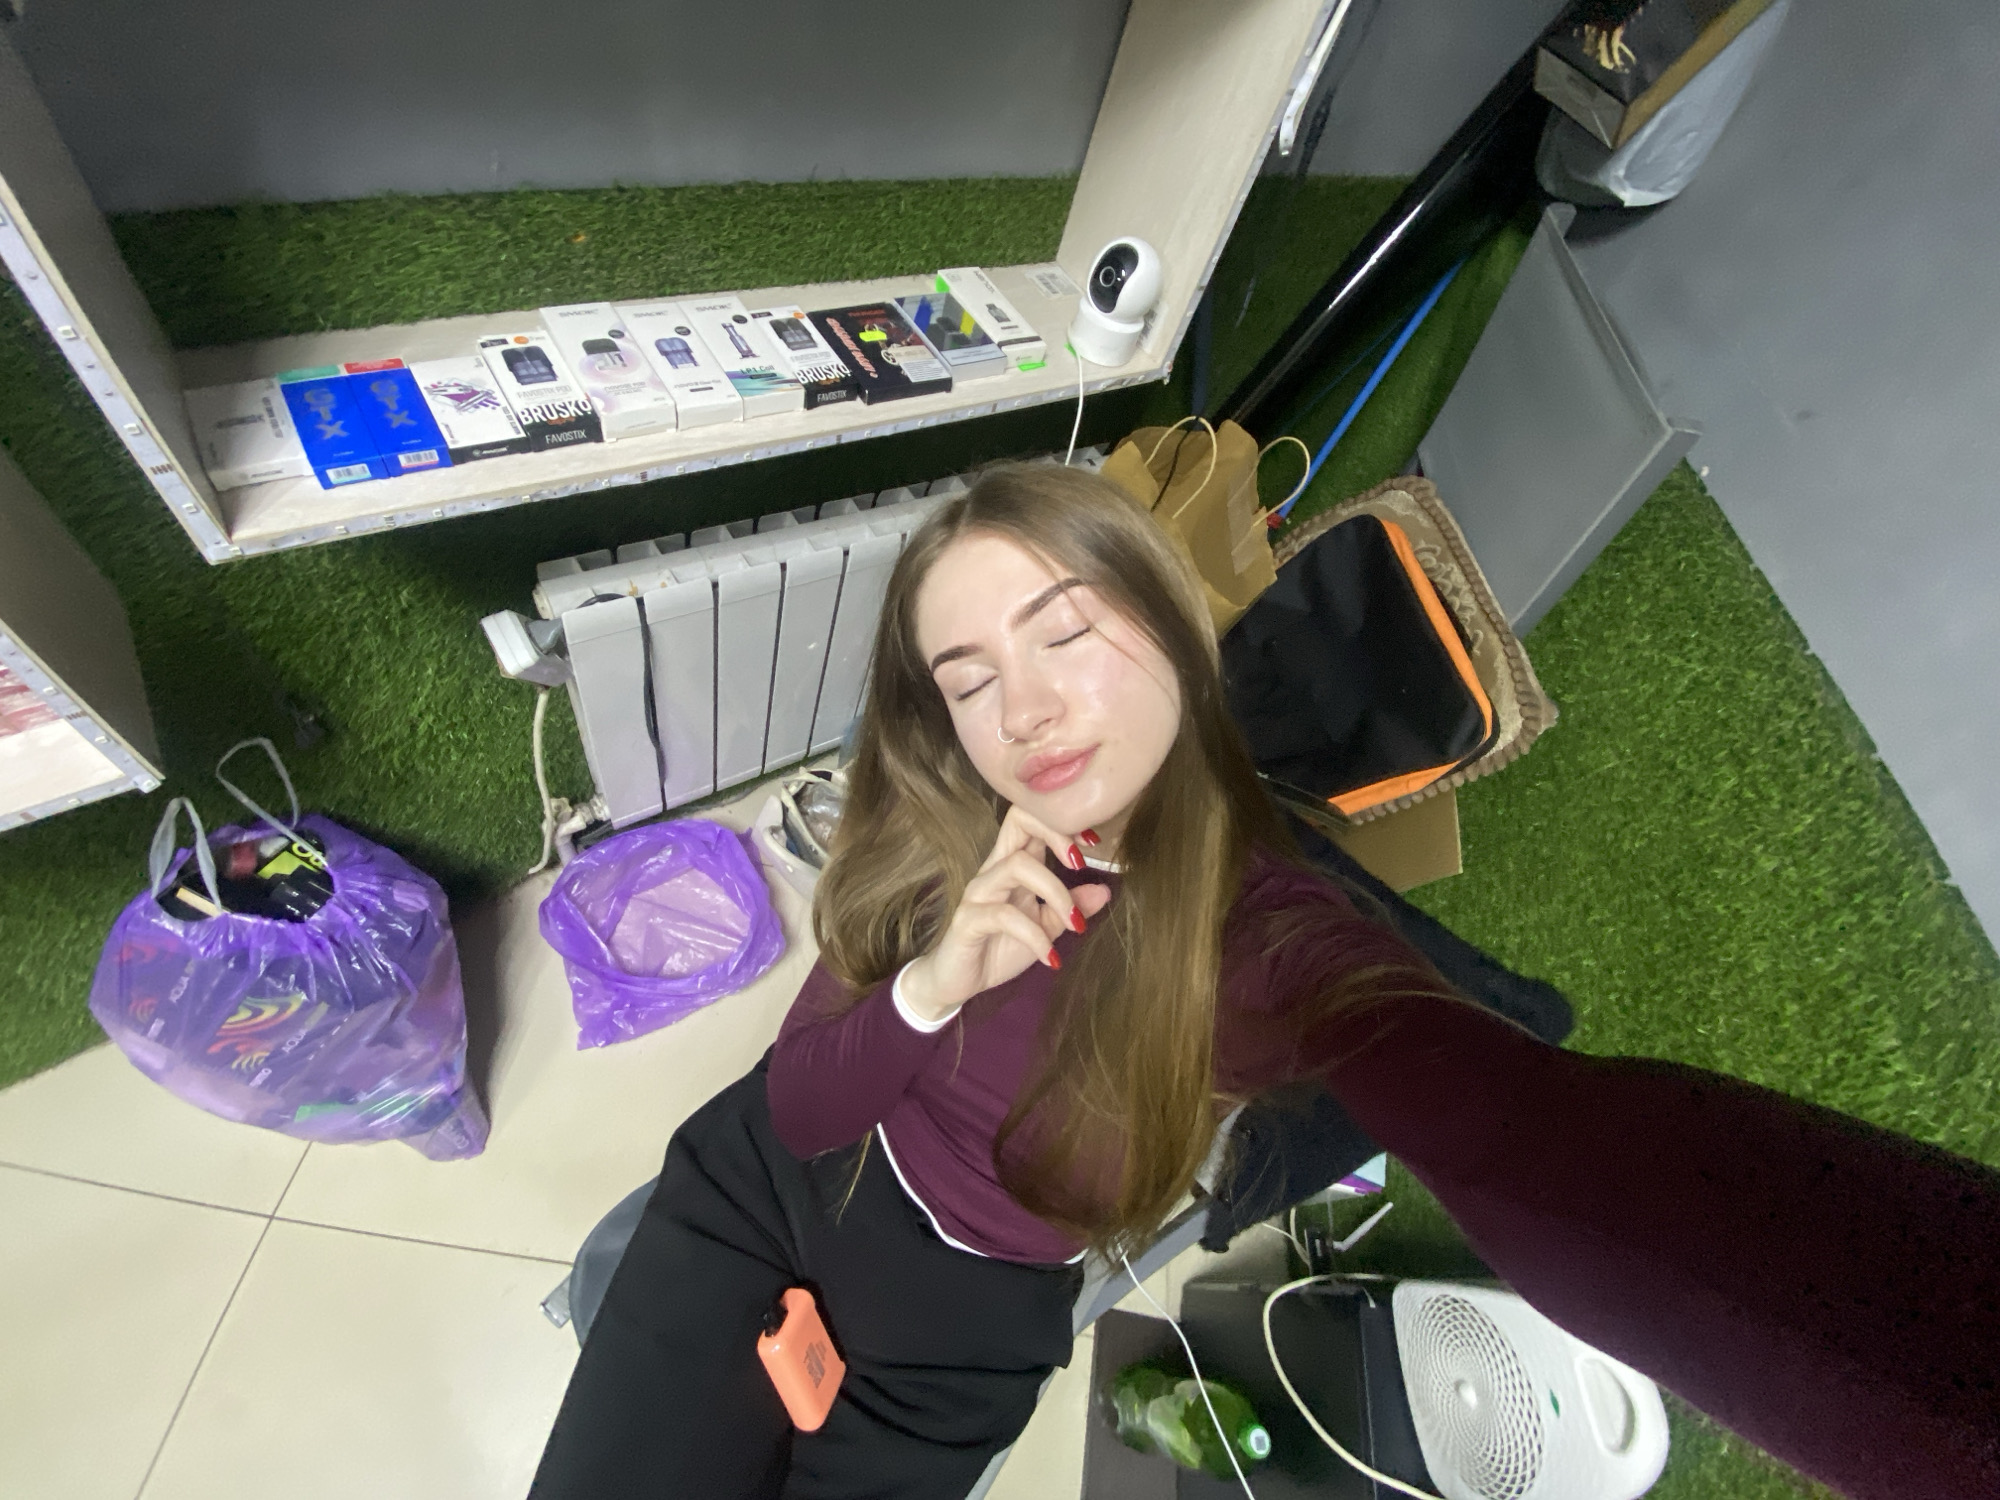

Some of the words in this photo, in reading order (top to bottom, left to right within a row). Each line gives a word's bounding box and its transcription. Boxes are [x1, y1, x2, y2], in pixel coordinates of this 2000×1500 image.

[795, 363, 852, 385] BRUSKO
[518, 400, 593, 425] BRUSKO
[545, 429, 587, 445] FAVOSTIX
